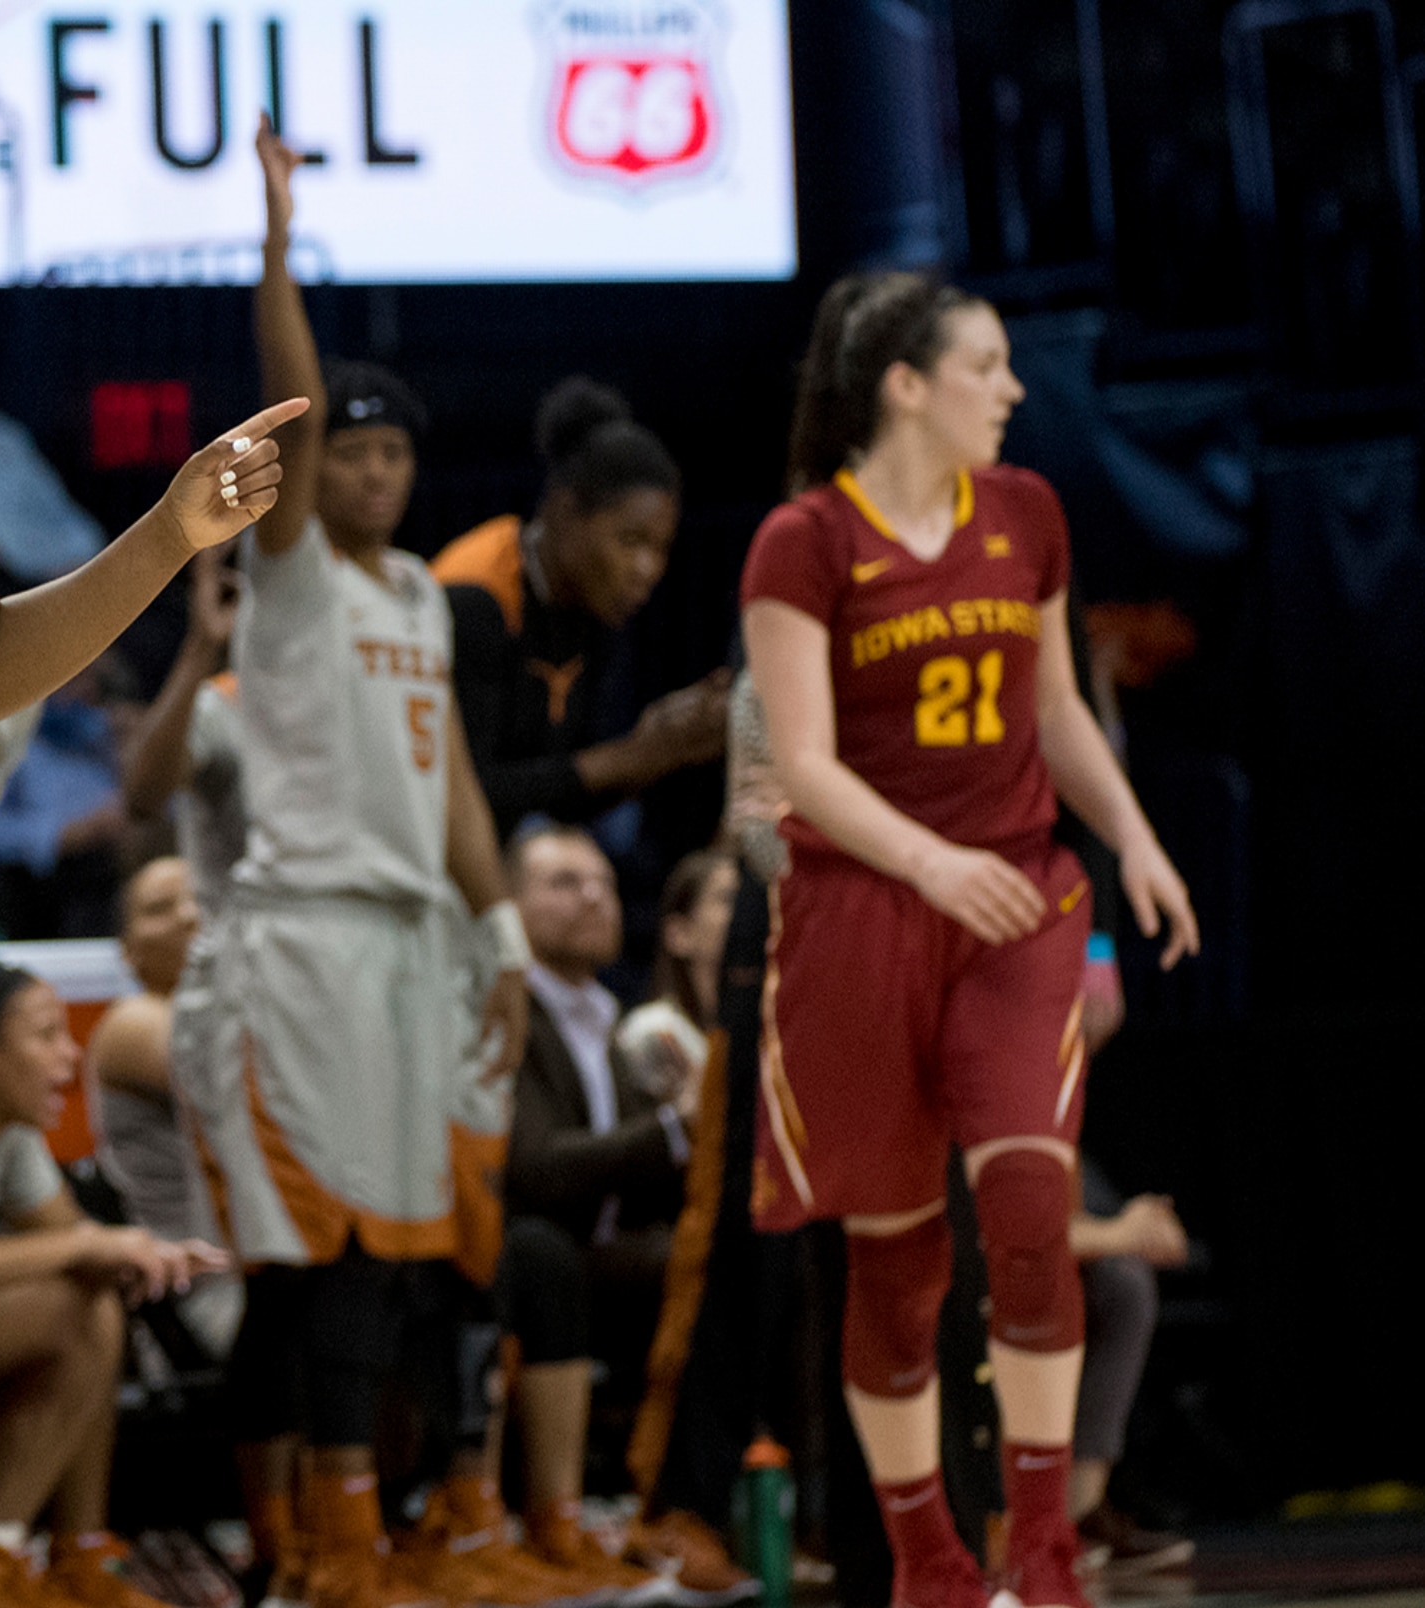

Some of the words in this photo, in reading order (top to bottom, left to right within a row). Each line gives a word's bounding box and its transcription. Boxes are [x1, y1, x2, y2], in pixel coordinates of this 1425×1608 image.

[50, 20, 417, 168] FULL
[570, 64, 694, 155] 66
[852, 604, 951, 668] IOWA
[406, 695, 436, 771] 5
[914, 648, 1005, 747] 21
